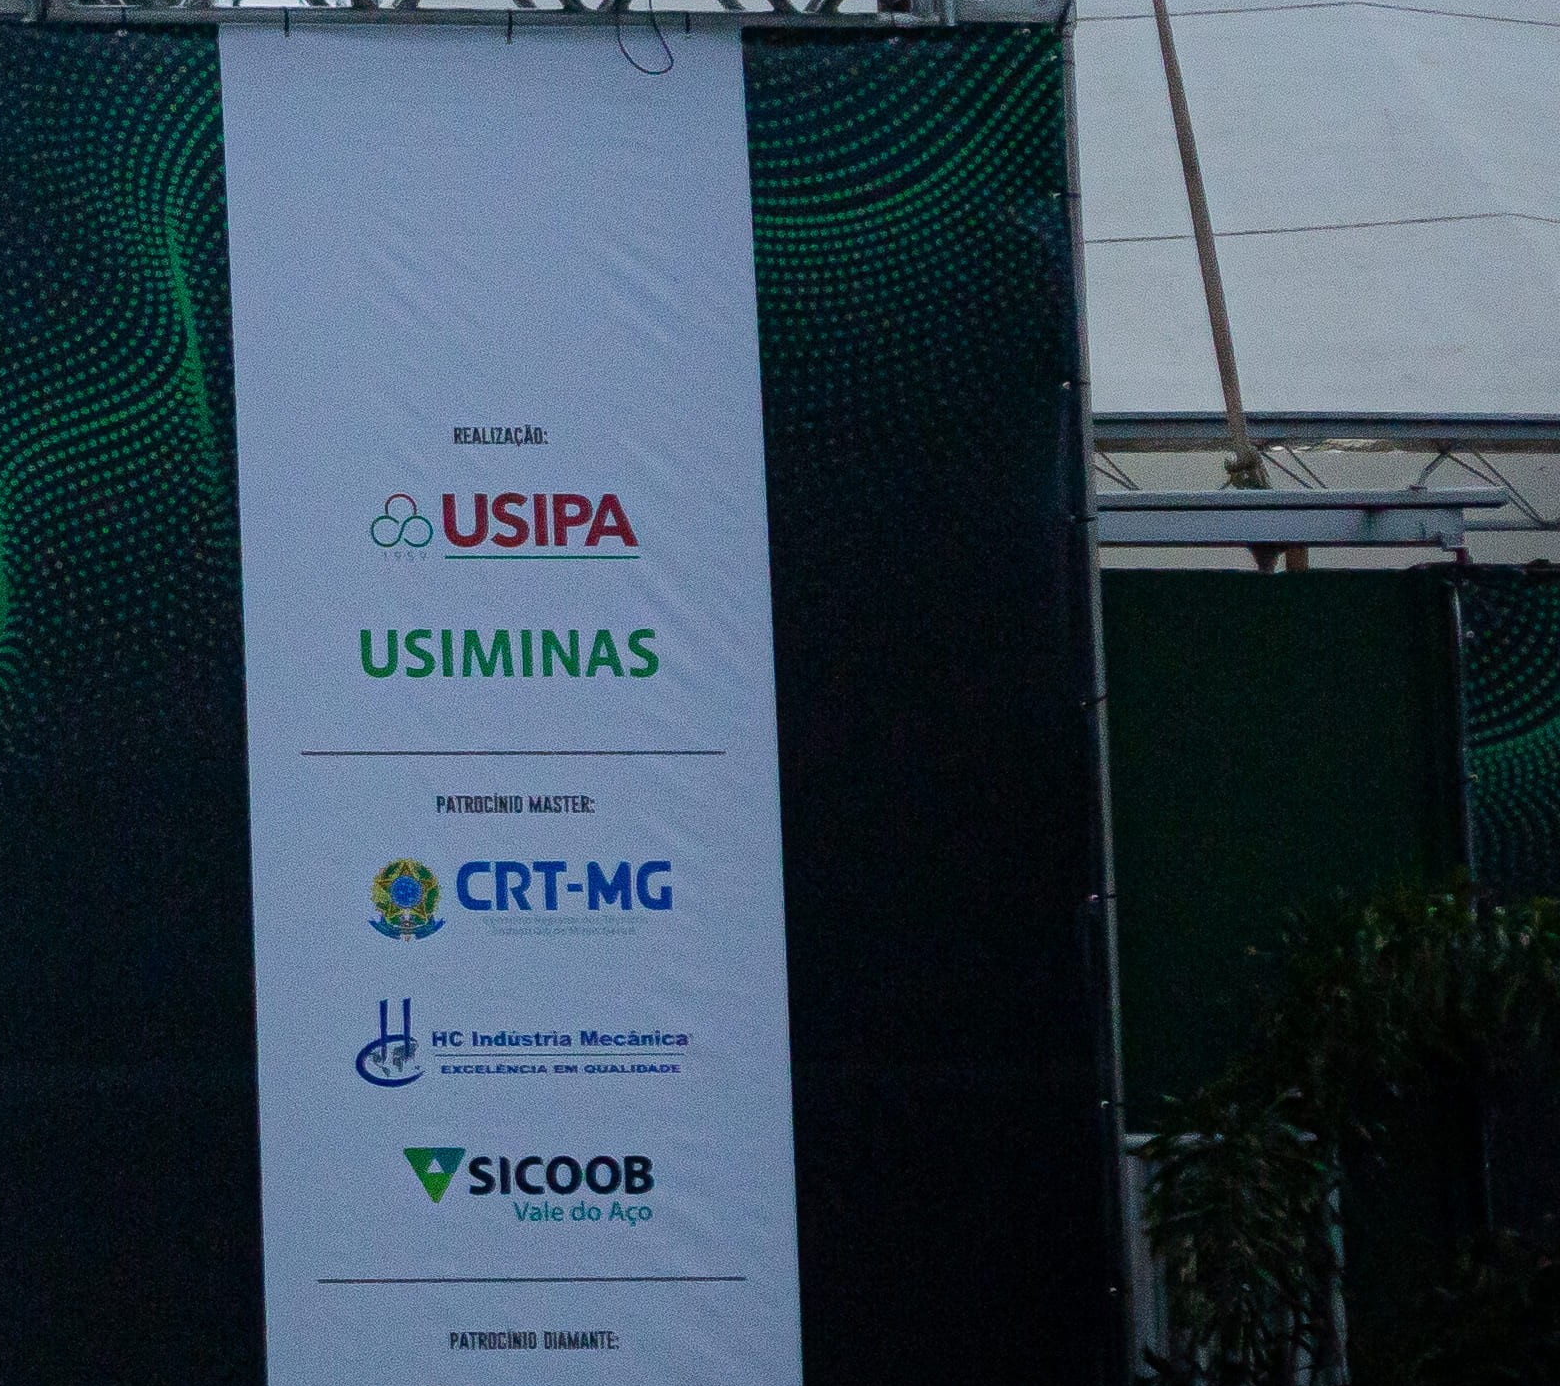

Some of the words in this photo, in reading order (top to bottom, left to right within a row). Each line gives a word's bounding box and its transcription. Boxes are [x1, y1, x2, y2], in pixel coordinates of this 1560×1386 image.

[453, 424, 549, 448] REALIZAÇÃO:
[442, 493, 639, 547] USIPA
[360, 628, 660, 678] USIMINAS
[528, 795, 596, 814] MASTER:
[456, 860, 673, 911] CRT-MG
[432, 1030, 463, 1047] HC
[472, 1028, 572, 1048] Indústria
[579, 1029, 689, 1047] Mecânica
[553, 1064, 579, 1074] EM
[469, 1156, 655, 1196] SICOOB
[514, 1202, 563, 1222] Vale
[570, 1202, 601, 1222] do
[608, 1202, 652, 1227] Aço
